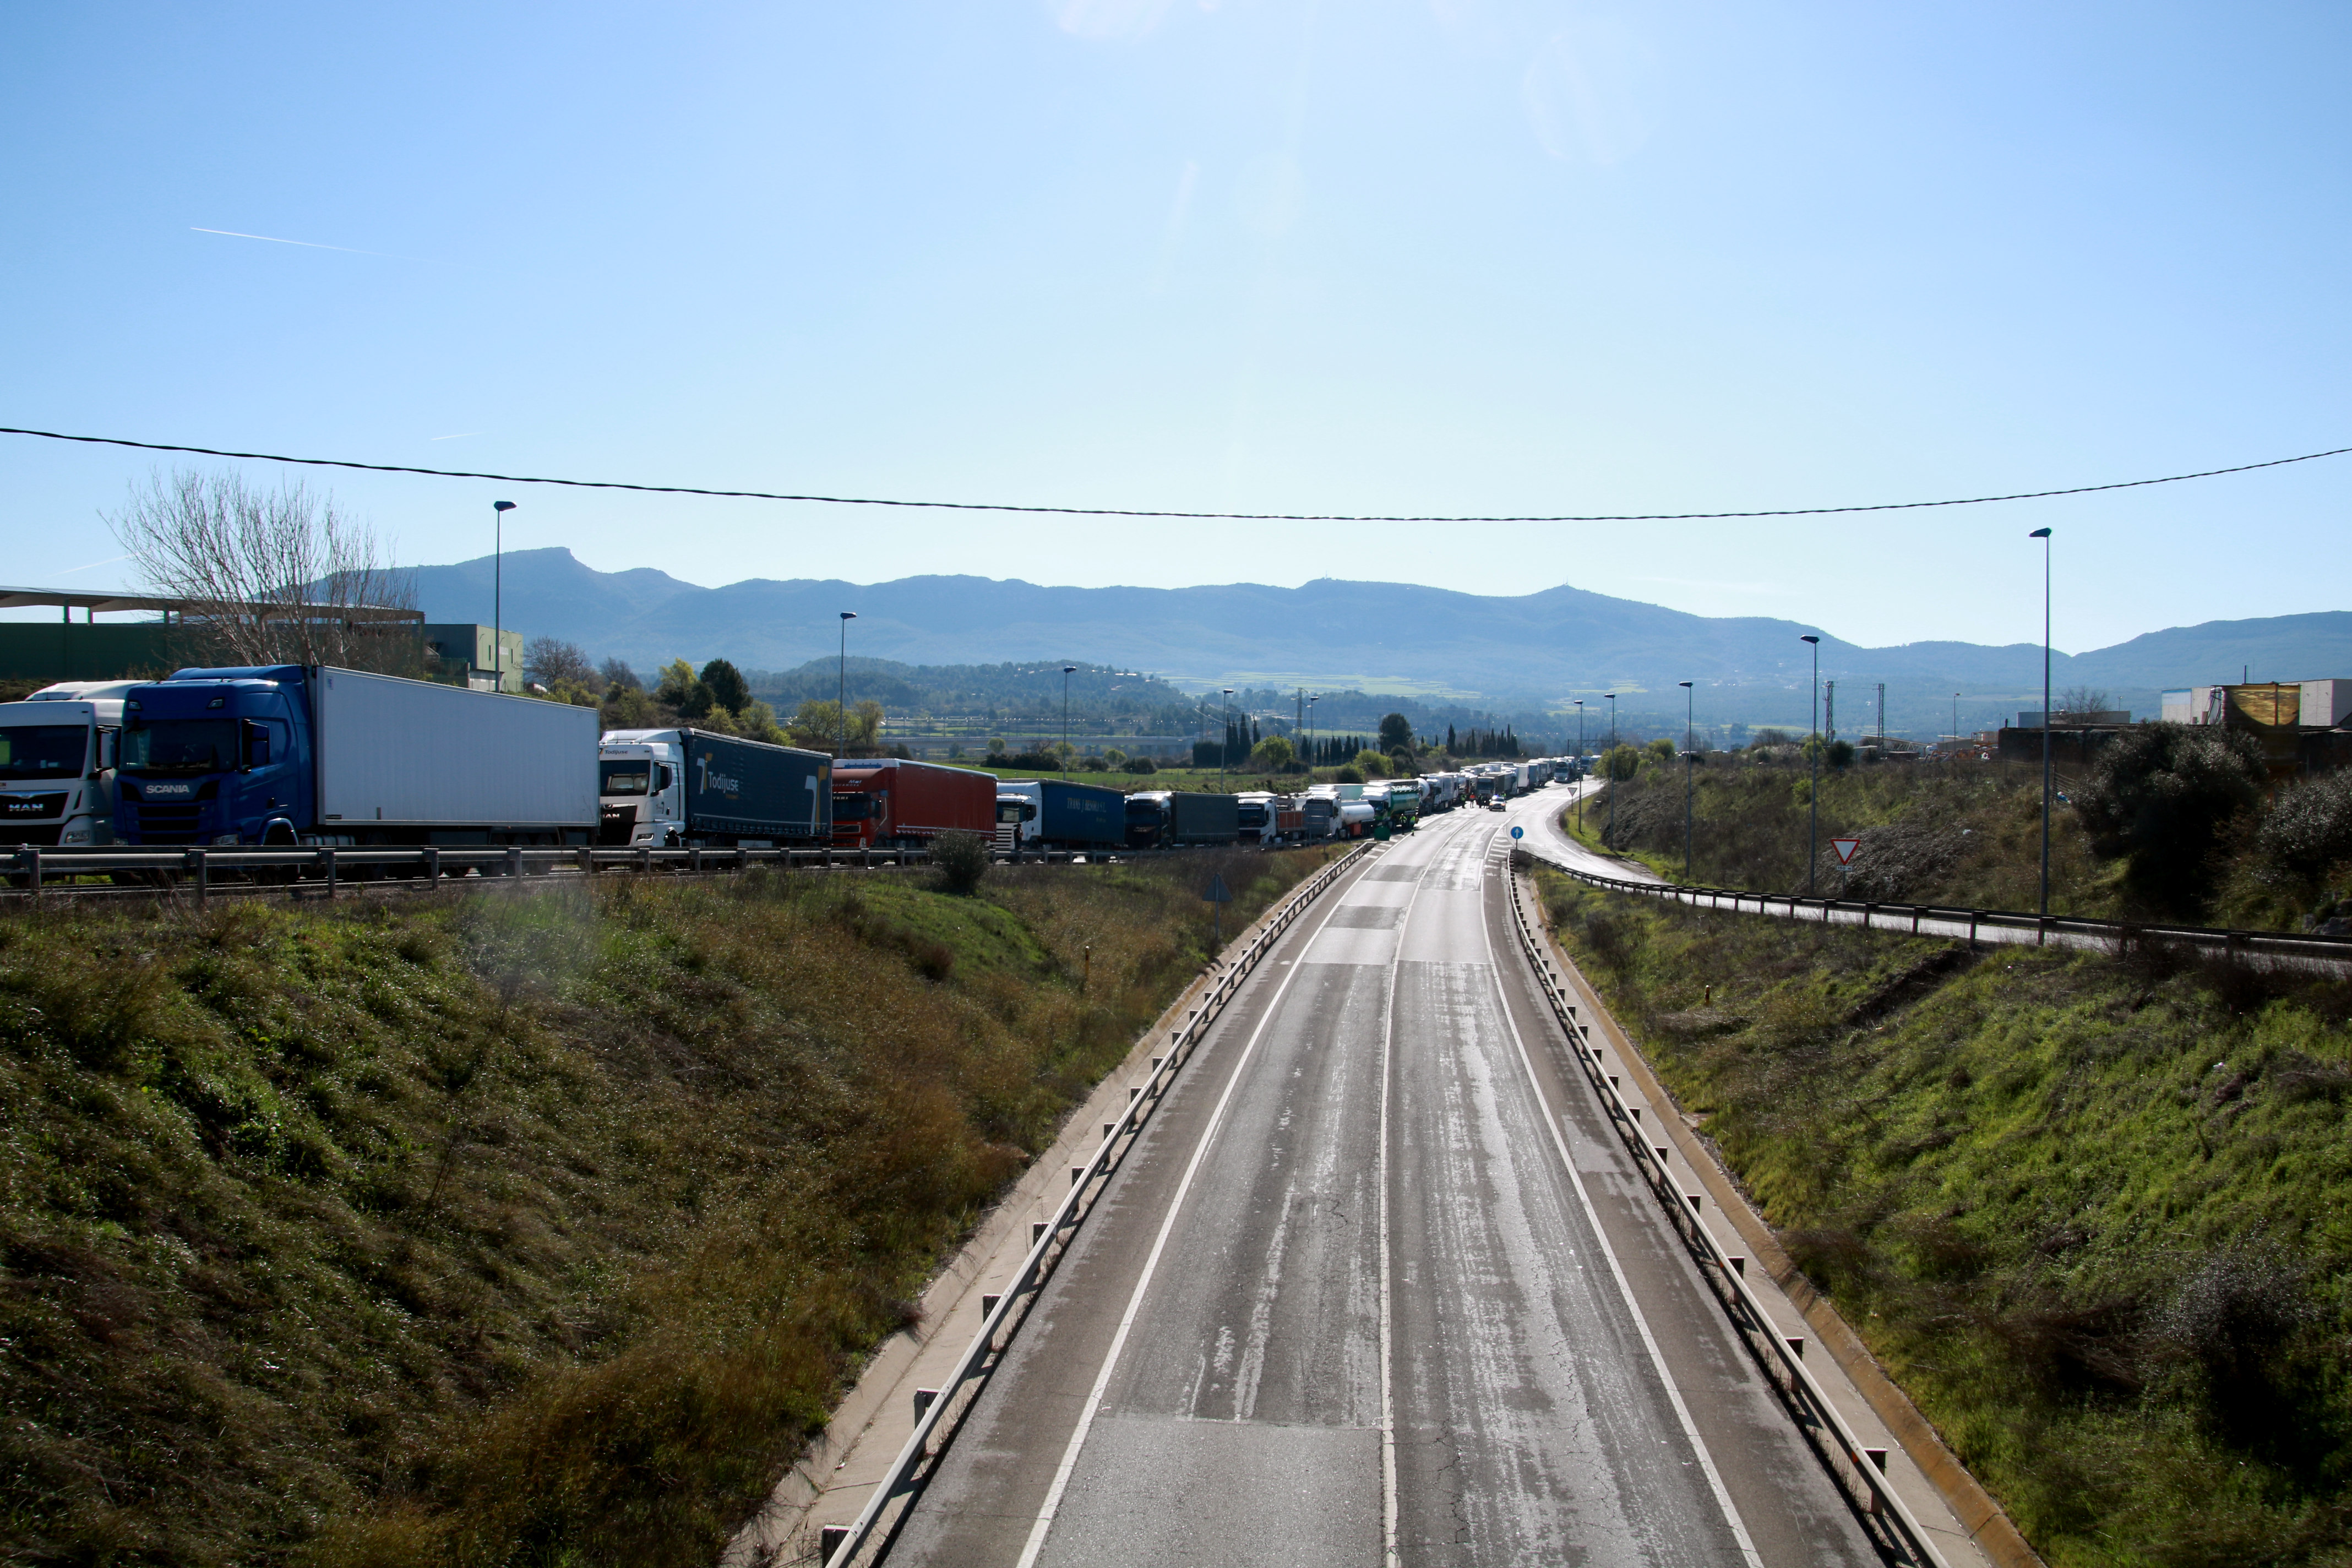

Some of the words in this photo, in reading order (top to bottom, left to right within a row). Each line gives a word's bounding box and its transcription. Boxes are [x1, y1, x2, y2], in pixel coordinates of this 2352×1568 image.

[707, 771, 739, 793] Todijuse
[145, 785, 190, 793] SCANIA
[9, 803, 43, 812] MAN
[1067, 797, 1081, 810] TRANS
